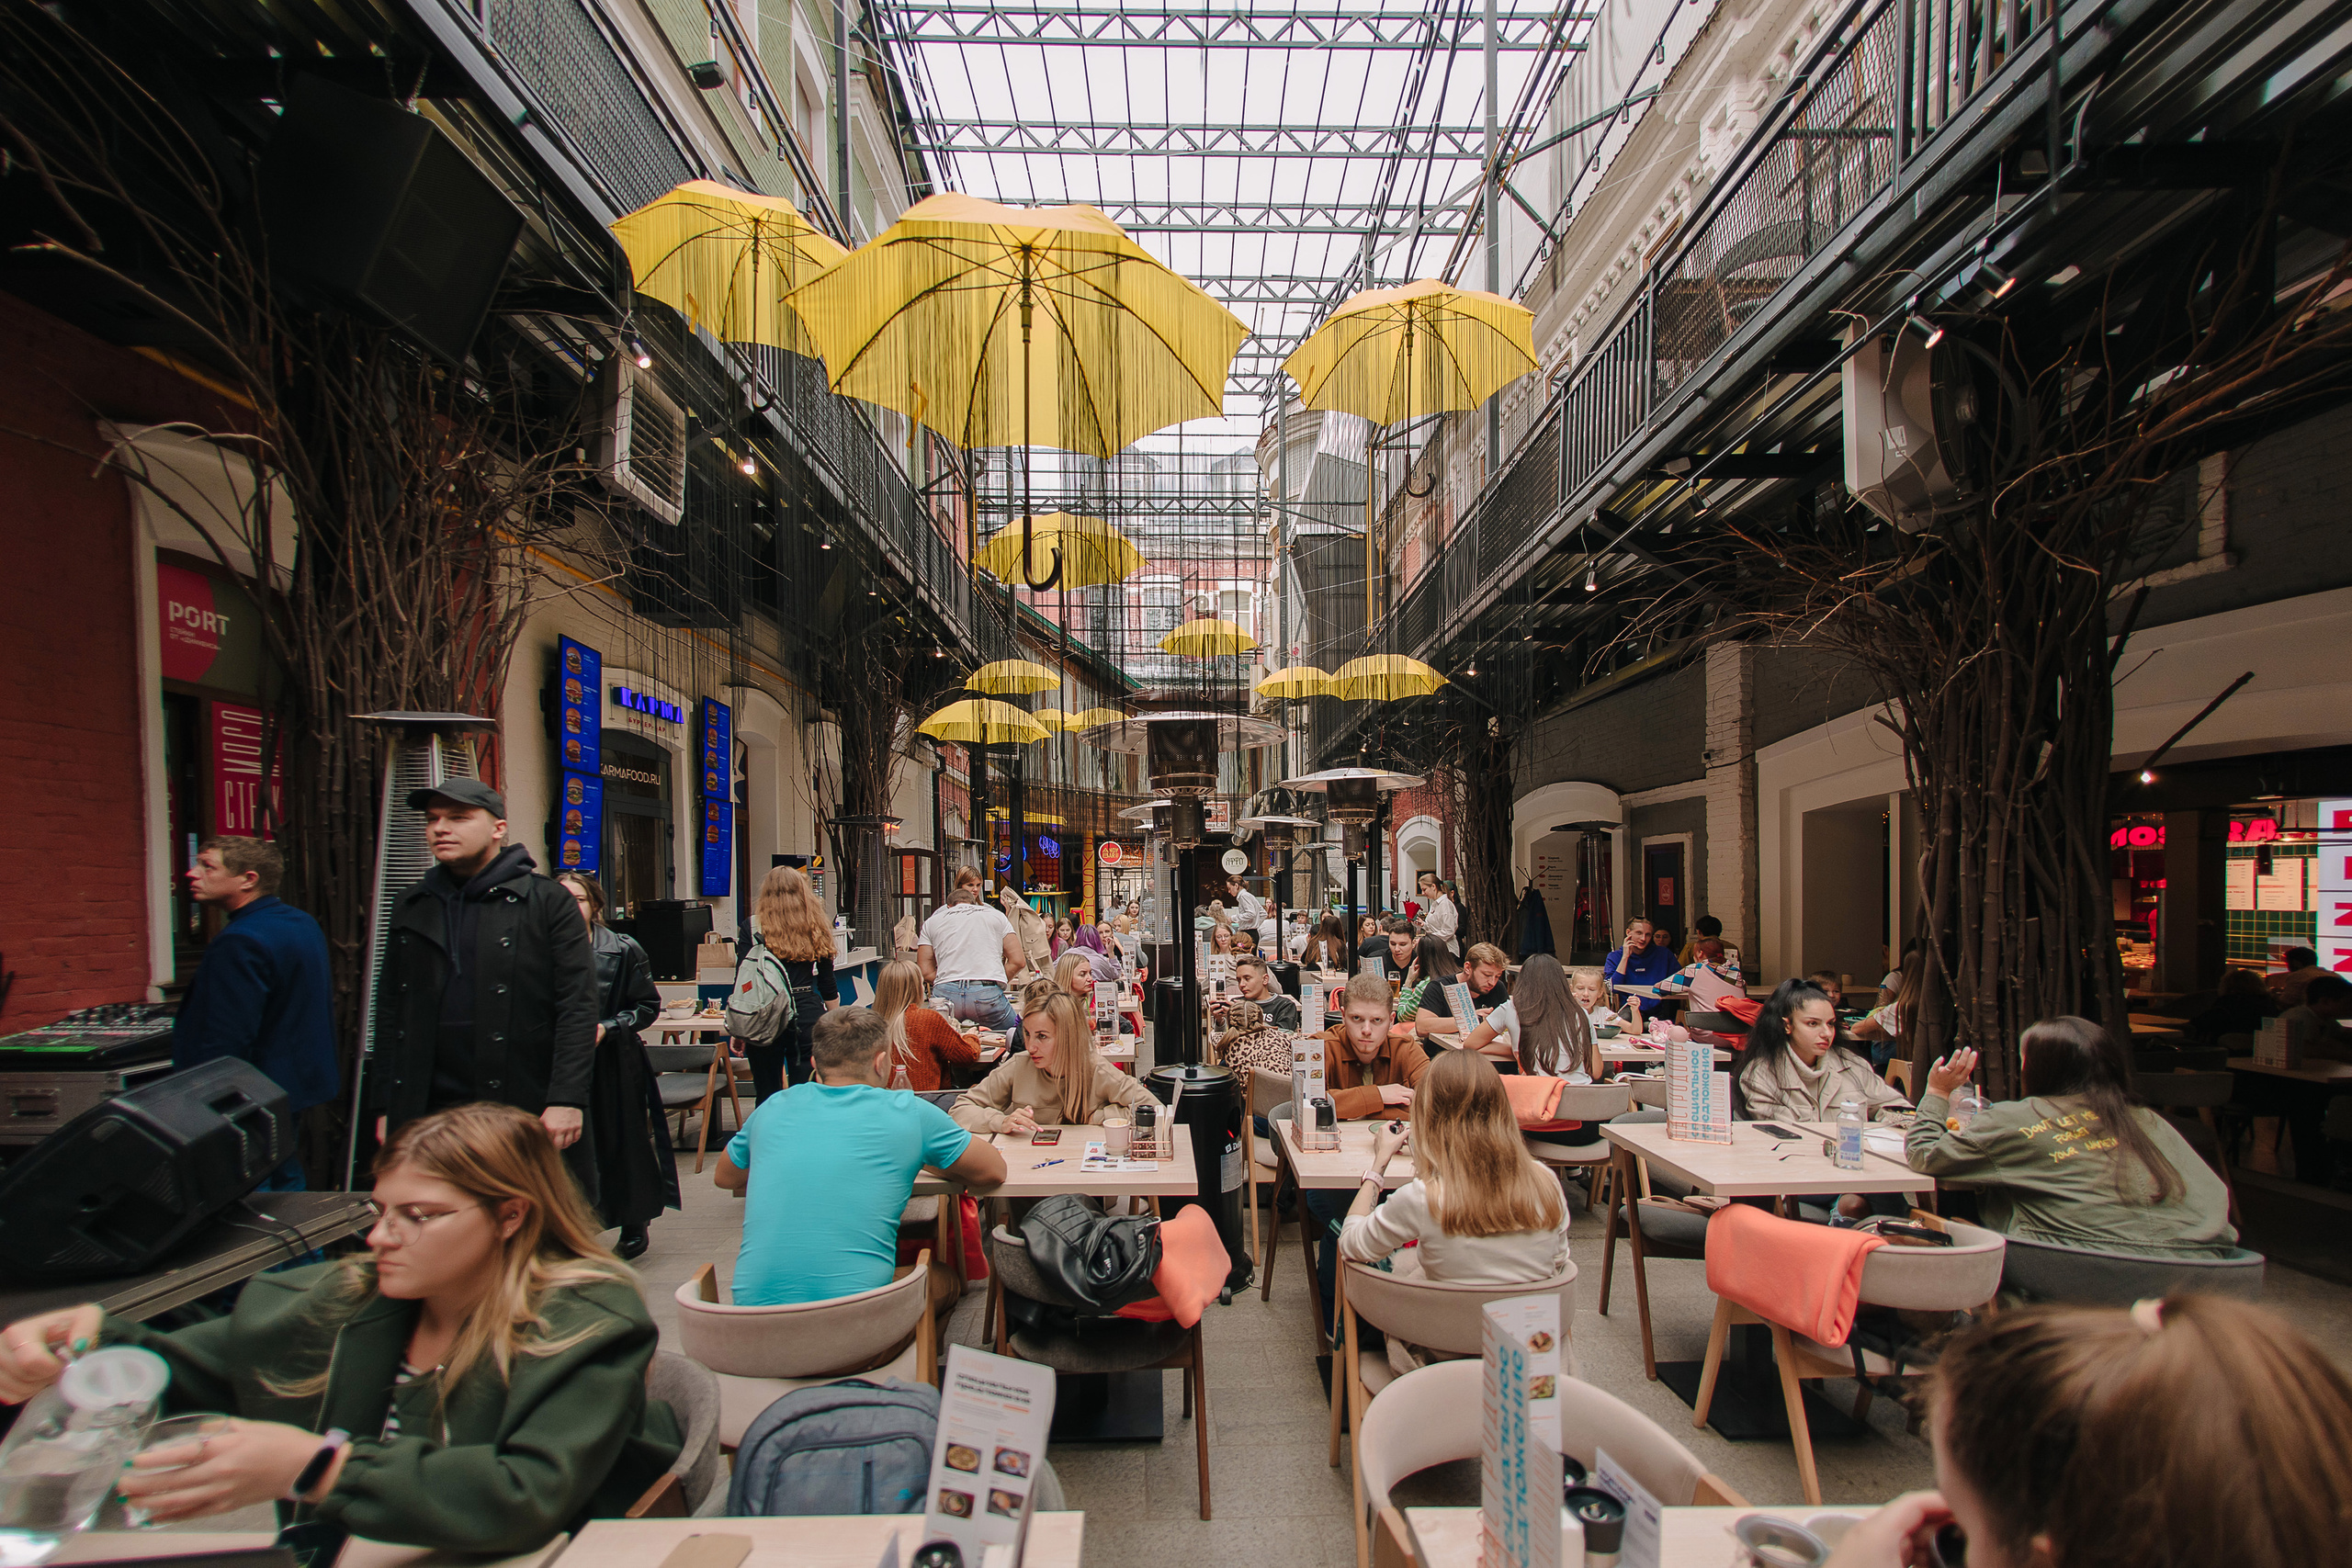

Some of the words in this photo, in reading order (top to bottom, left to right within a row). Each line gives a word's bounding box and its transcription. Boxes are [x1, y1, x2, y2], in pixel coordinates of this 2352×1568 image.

[169, 601, 230, 636] PORT
[619, 686, 684, 724] КАРМА
[2056, 1114, 2079, 1127] LET
[2081, 1111, 2099, 1121] ME
[2052, 1126, 2090, 1145] FORGET
[2049, 1146, 2079, 1164] YOUR
